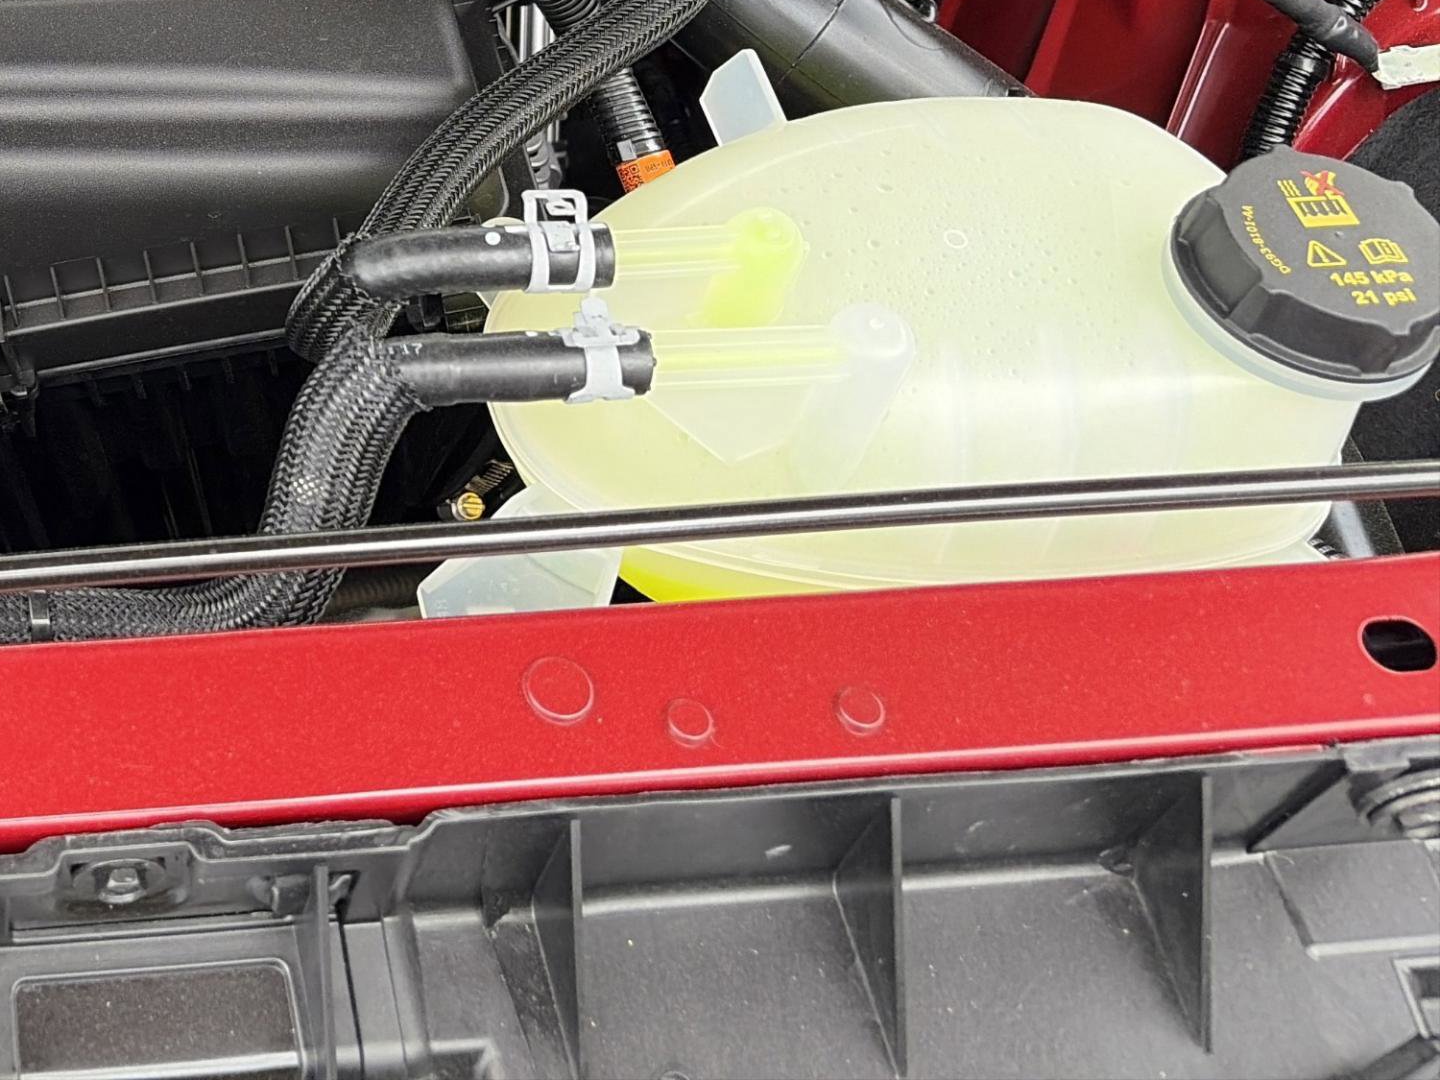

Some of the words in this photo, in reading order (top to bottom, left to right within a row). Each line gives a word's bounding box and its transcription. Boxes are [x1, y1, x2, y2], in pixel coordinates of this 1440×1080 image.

[1329, 272, 1370, 287] 145
[1370, 269, 1414, 285] kPa
[1351, 289, 1380, 306] 21
[1381, 287, 1417, 307] psi
